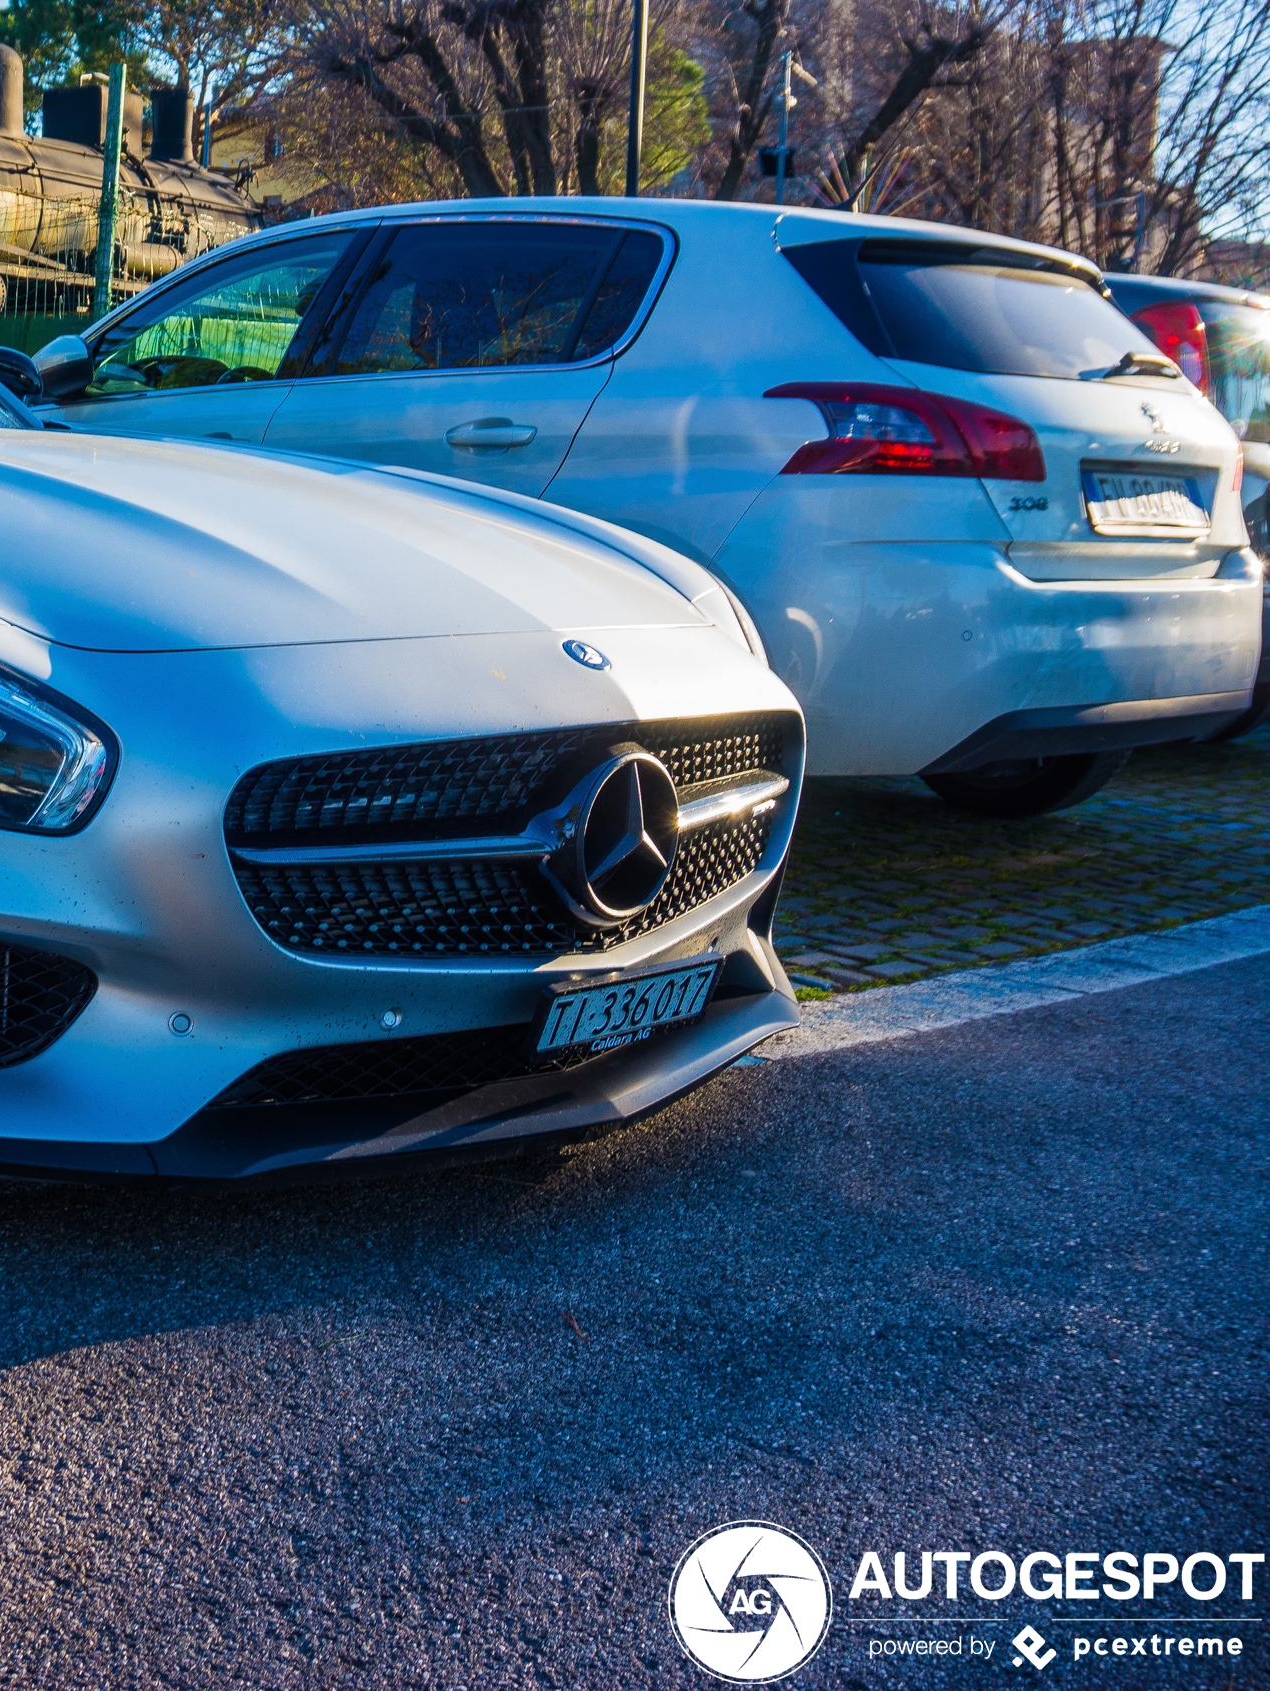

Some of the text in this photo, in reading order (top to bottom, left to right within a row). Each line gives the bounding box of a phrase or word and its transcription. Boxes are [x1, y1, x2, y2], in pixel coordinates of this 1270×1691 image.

[1009, 496, 1050, 511] 308
[591, 1027, 652, 1052] Caldara AG
